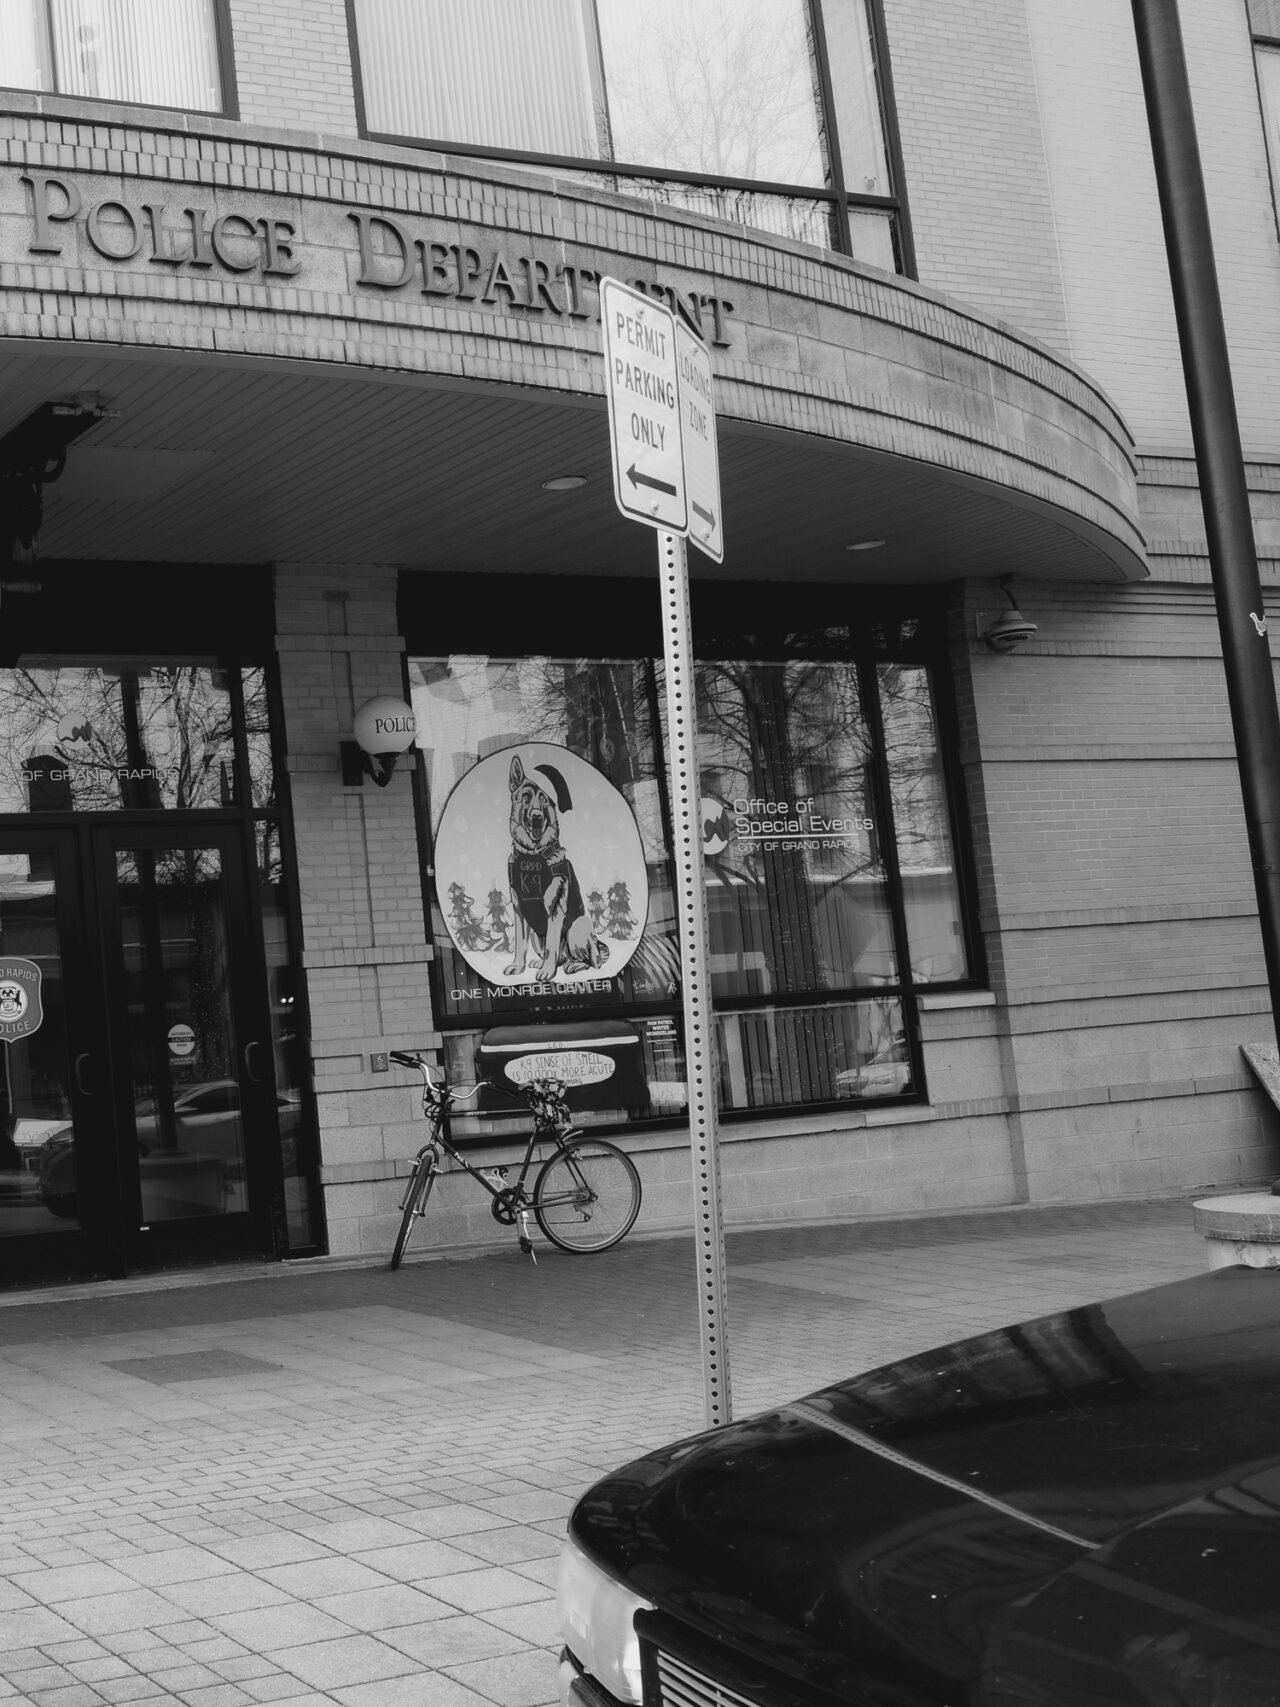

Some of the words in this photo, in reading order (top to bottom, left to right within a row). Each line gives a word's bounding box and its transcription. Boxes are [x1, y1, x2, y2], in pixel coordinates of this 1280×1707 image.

[20, 174, 302, 276] POLICE
[616, 311, 666, 360] PERMIT
[615, 357, 675, 409] PARKING
[680, 354, 710, 404] LOADING
[689, 401, 708, 440] ZONE
[631, 412, 665, 451] ONLY
[21, 770, 44, 781] OF
[50, 768, 112, 780] GRAND
[117, 768, 178, 779] RAPIDS
[733, 798, 788, 814] Office
[796, 797, 814, 813] of
[735, 817, 803, 836] Special
[810, 816, 873, 831] Events
[737, 842, 761, 851] CITY
[764, 841, 779, 850] OF
[782, 840, 820, 850] GRAND
[822, 839, 860, 849] RAPIDS
[520, 861, 542, 871] GRPD
[6, 968, 37, 981] RAPIDS
[451, 988, 482, 1000] ONE
[487, 984, 551, 998] MONROE
[556, 980, 612, 994] CENTER
[536, 1055, 560, 1069] SENSE
[562, 1053, 573, 1066] OF
[576, 1053, 603, 1065] SMELL
[512, 1070, 521, 1082] IS
[561, 1066, 587, 1078] MORE
[588, 1063, 614, 1075] ACUTE
